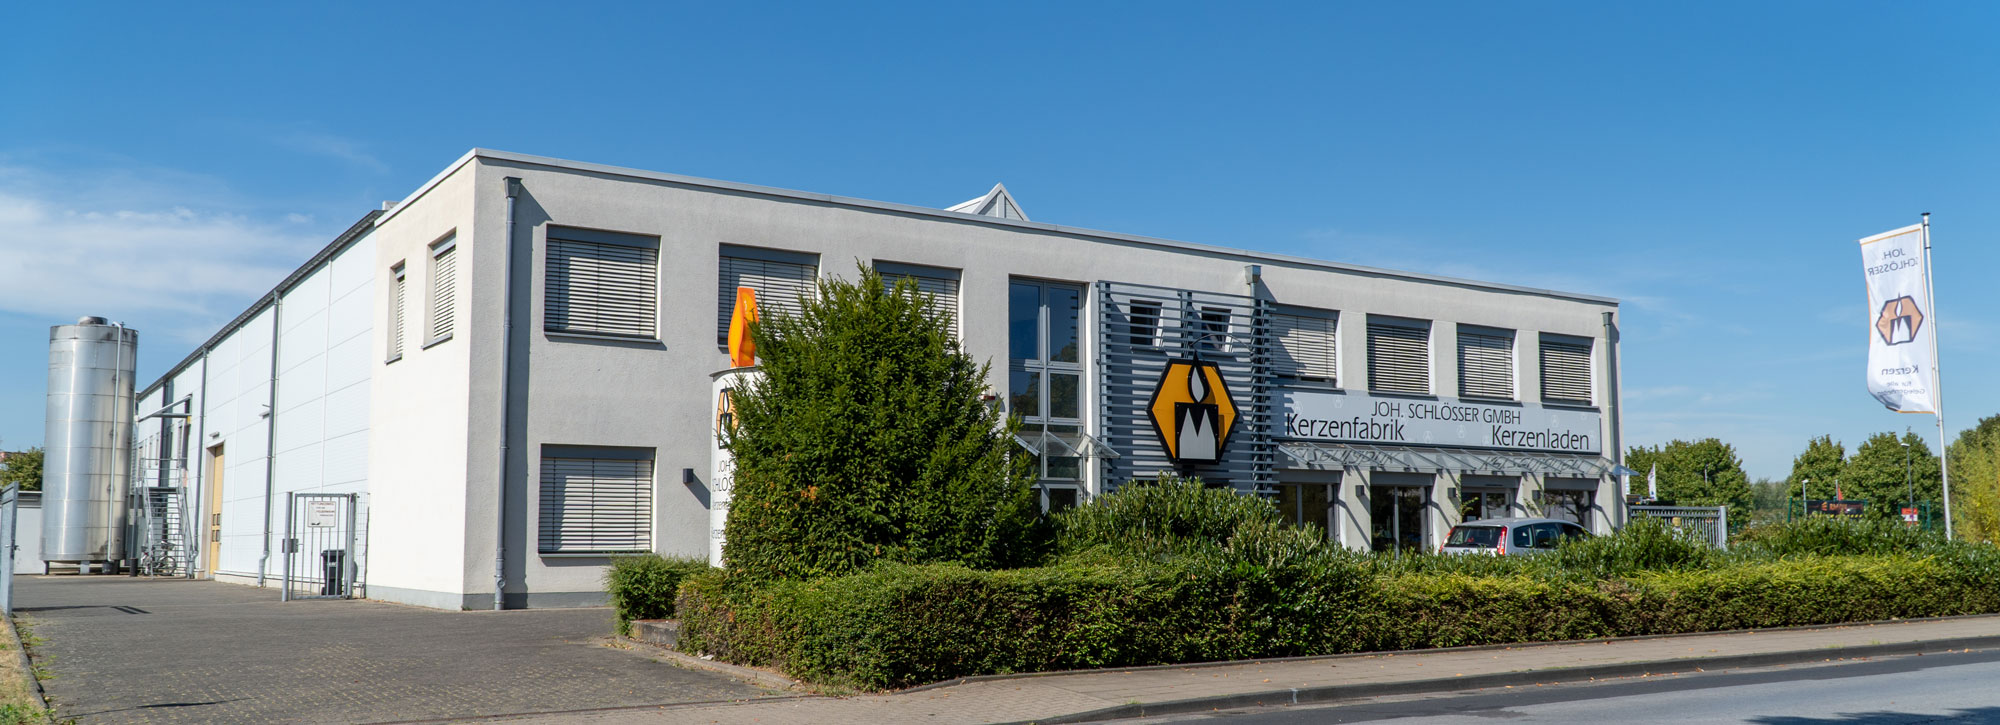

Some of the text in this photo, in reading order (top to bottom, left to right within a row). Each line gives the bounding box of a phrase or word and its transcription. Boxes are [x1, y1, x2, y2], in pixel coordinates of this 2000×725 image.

[1371, 401, 1521, 425] JOH. SCHLÖSSER GMBH
[1286, 413, 1405, 441] Kerzenfabrik
[1492, 425, 1589, 450] Kerzenladen
